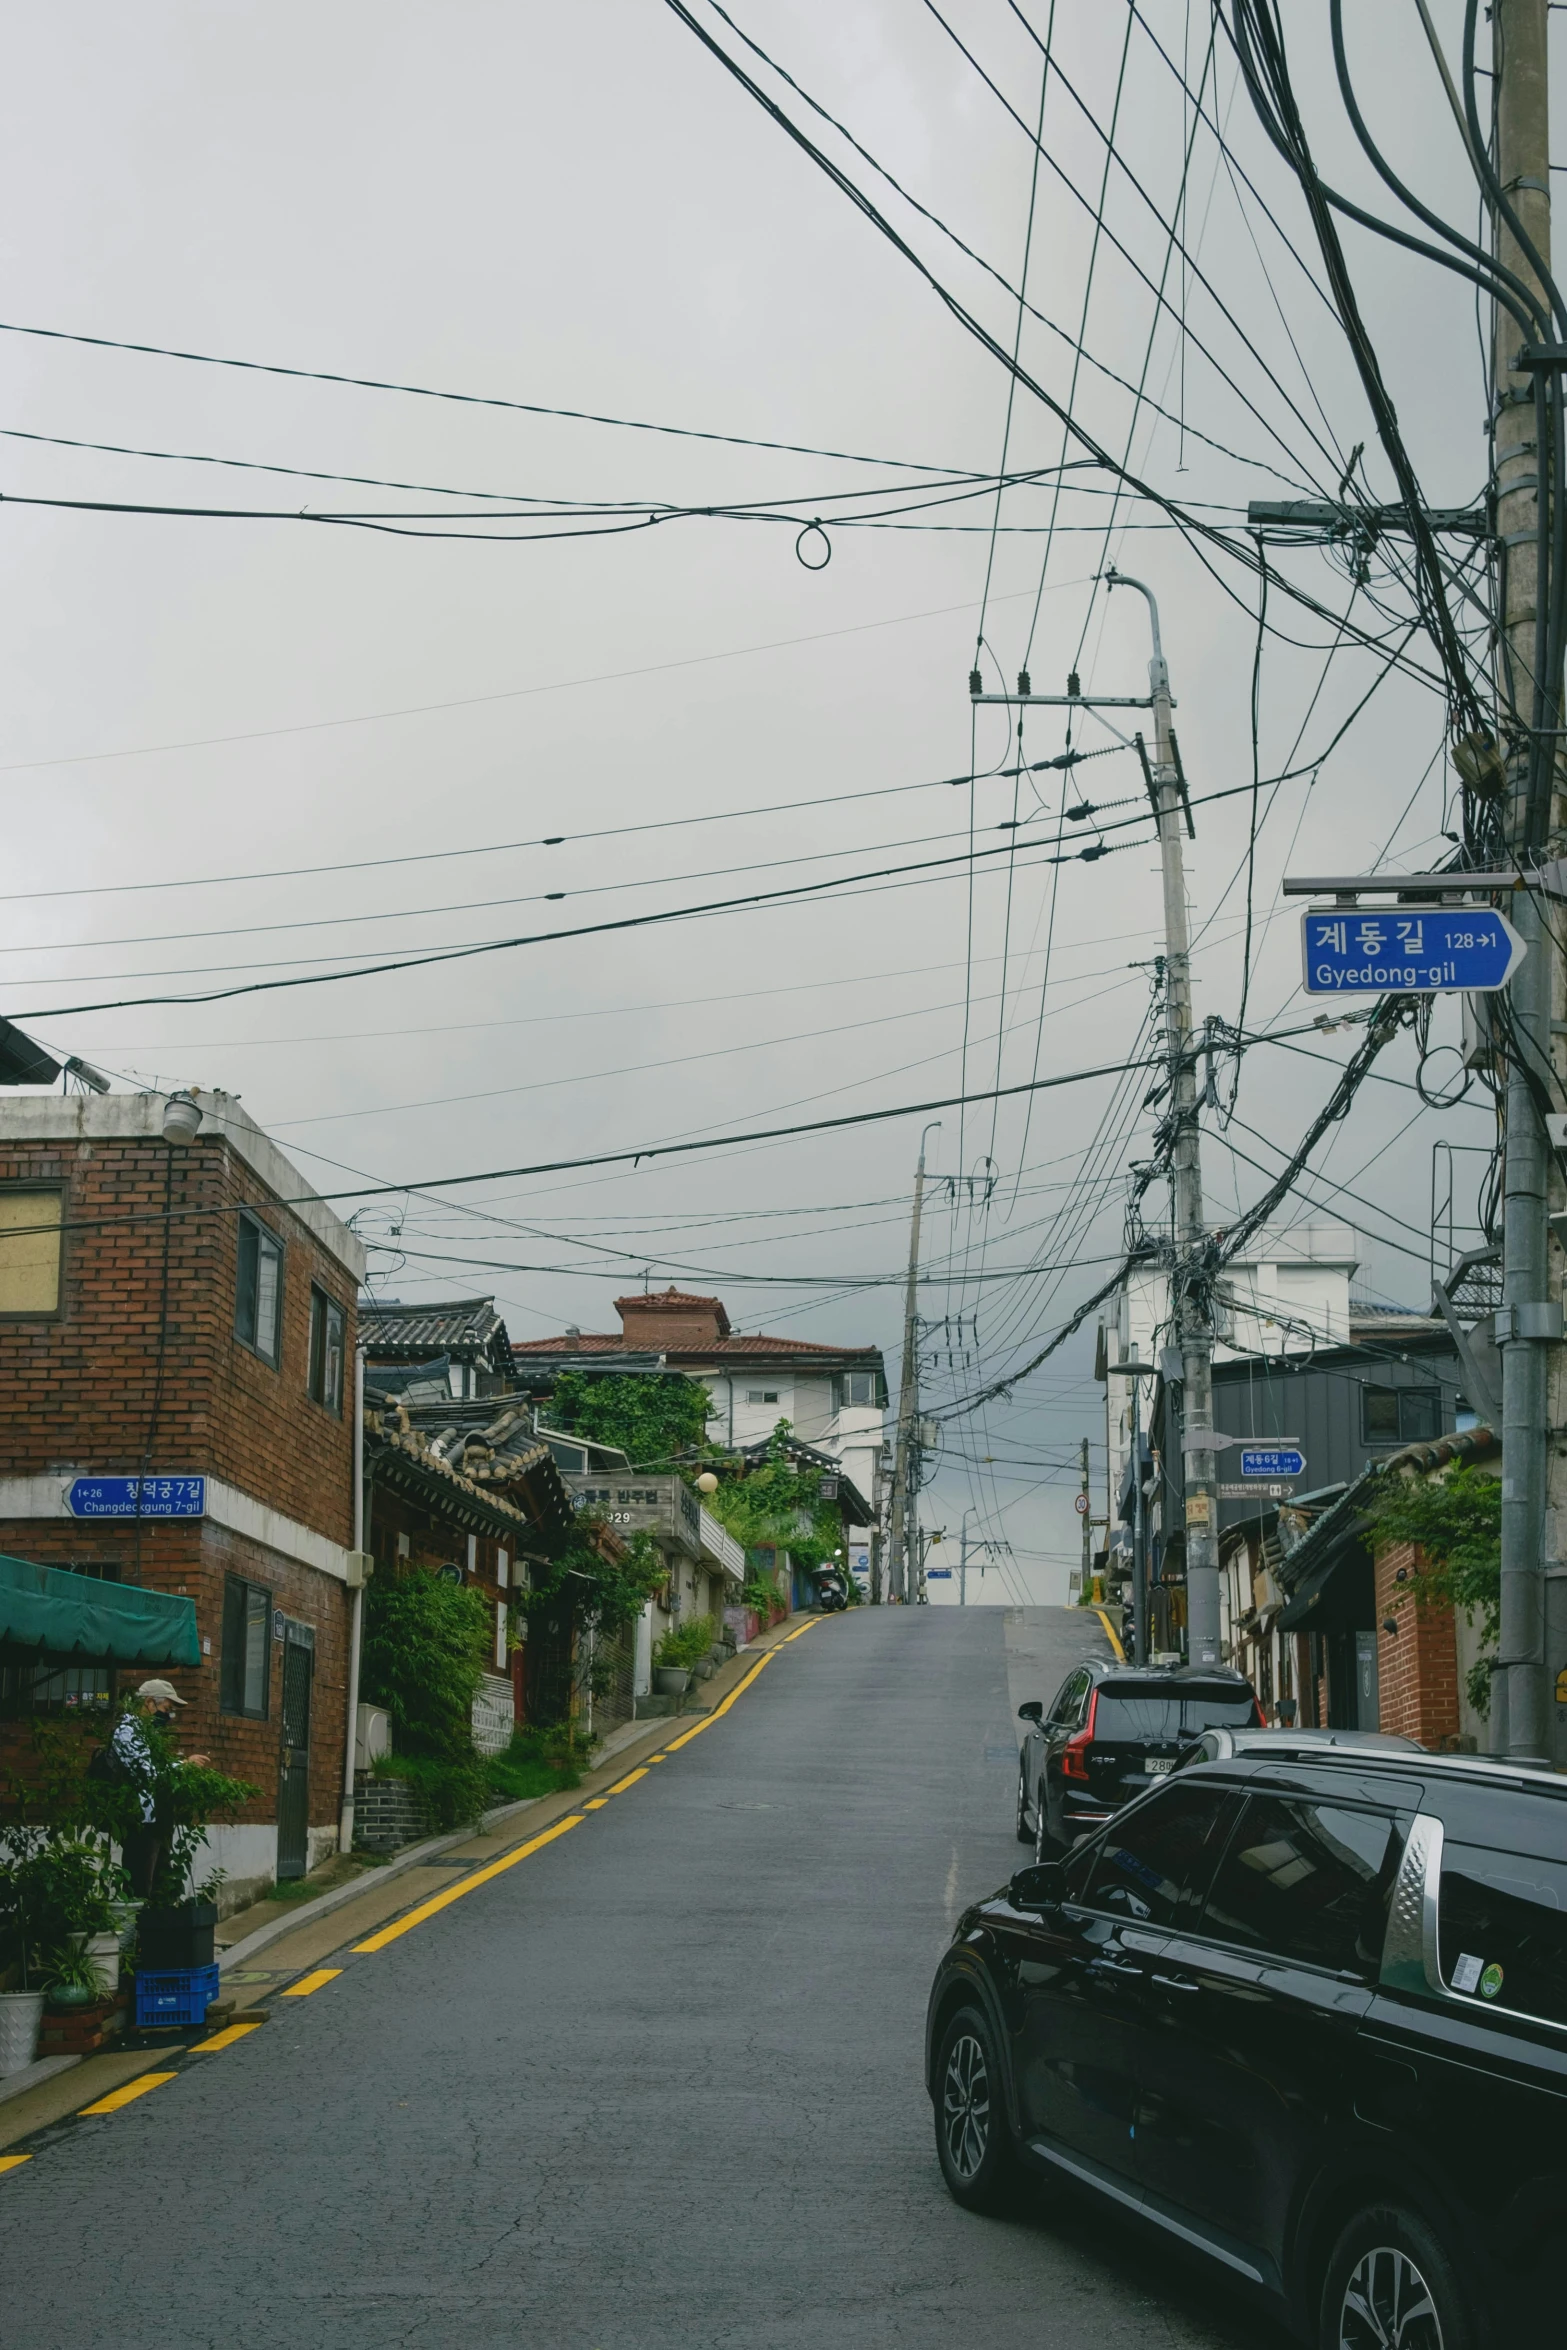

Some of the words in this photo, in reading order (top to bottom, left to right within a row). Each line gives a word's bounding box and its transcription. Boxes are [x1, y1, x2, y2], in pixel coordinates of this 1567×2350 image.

[1316, 919, 1424, 956] 계동길
[1444, 933, 1474, 950] 128
[1316, 962, 1456, 988] Gyedong-gil
[90, 1489, 102, 1498] 26
[175, 1501, 200, 1514] 7-gil
[1078, 1499, 1086, 1509] 30
